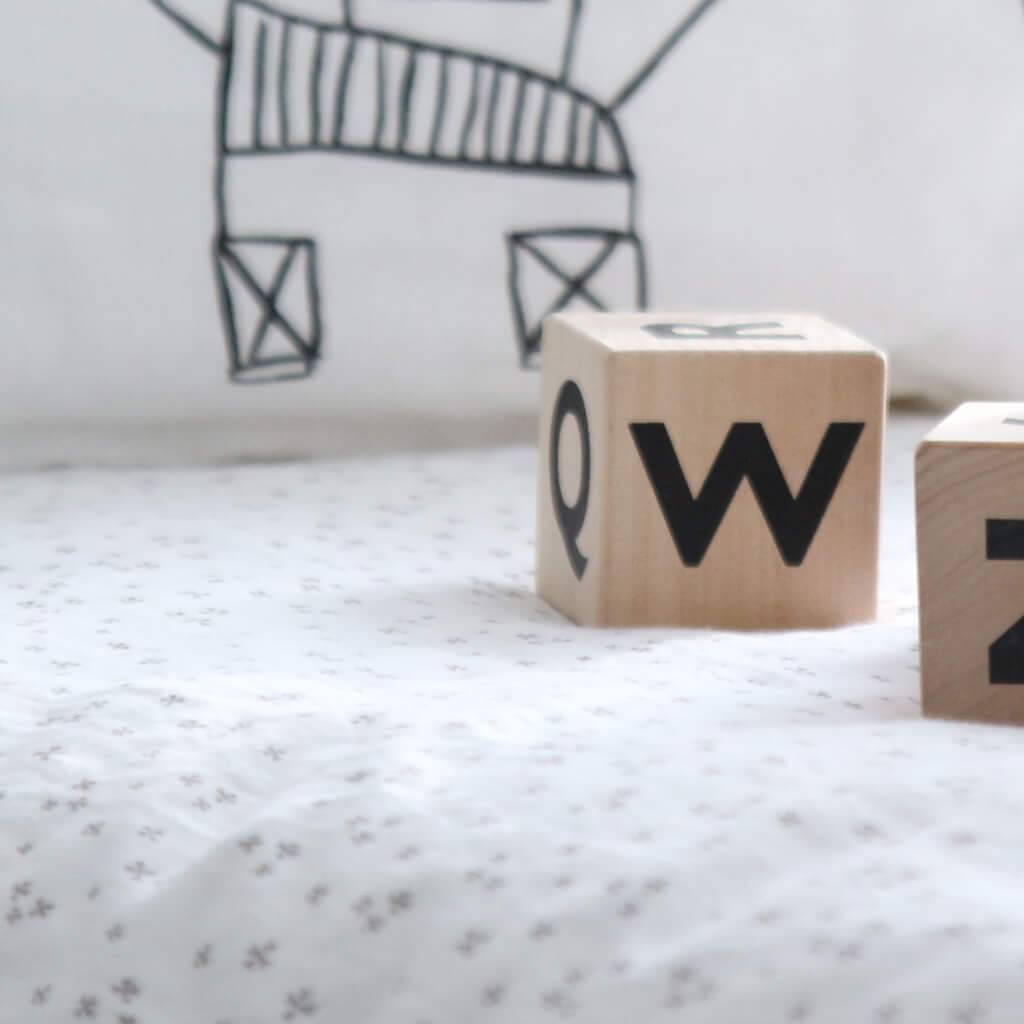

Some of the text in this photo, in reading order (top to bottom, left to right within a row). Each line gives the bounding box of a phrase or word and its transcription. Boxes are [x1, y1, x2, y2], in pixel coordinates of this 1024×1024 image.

[640, 321, 809, 340] R
[549, 380, 591, 582] Q
[629, 422, 866, 568] W
